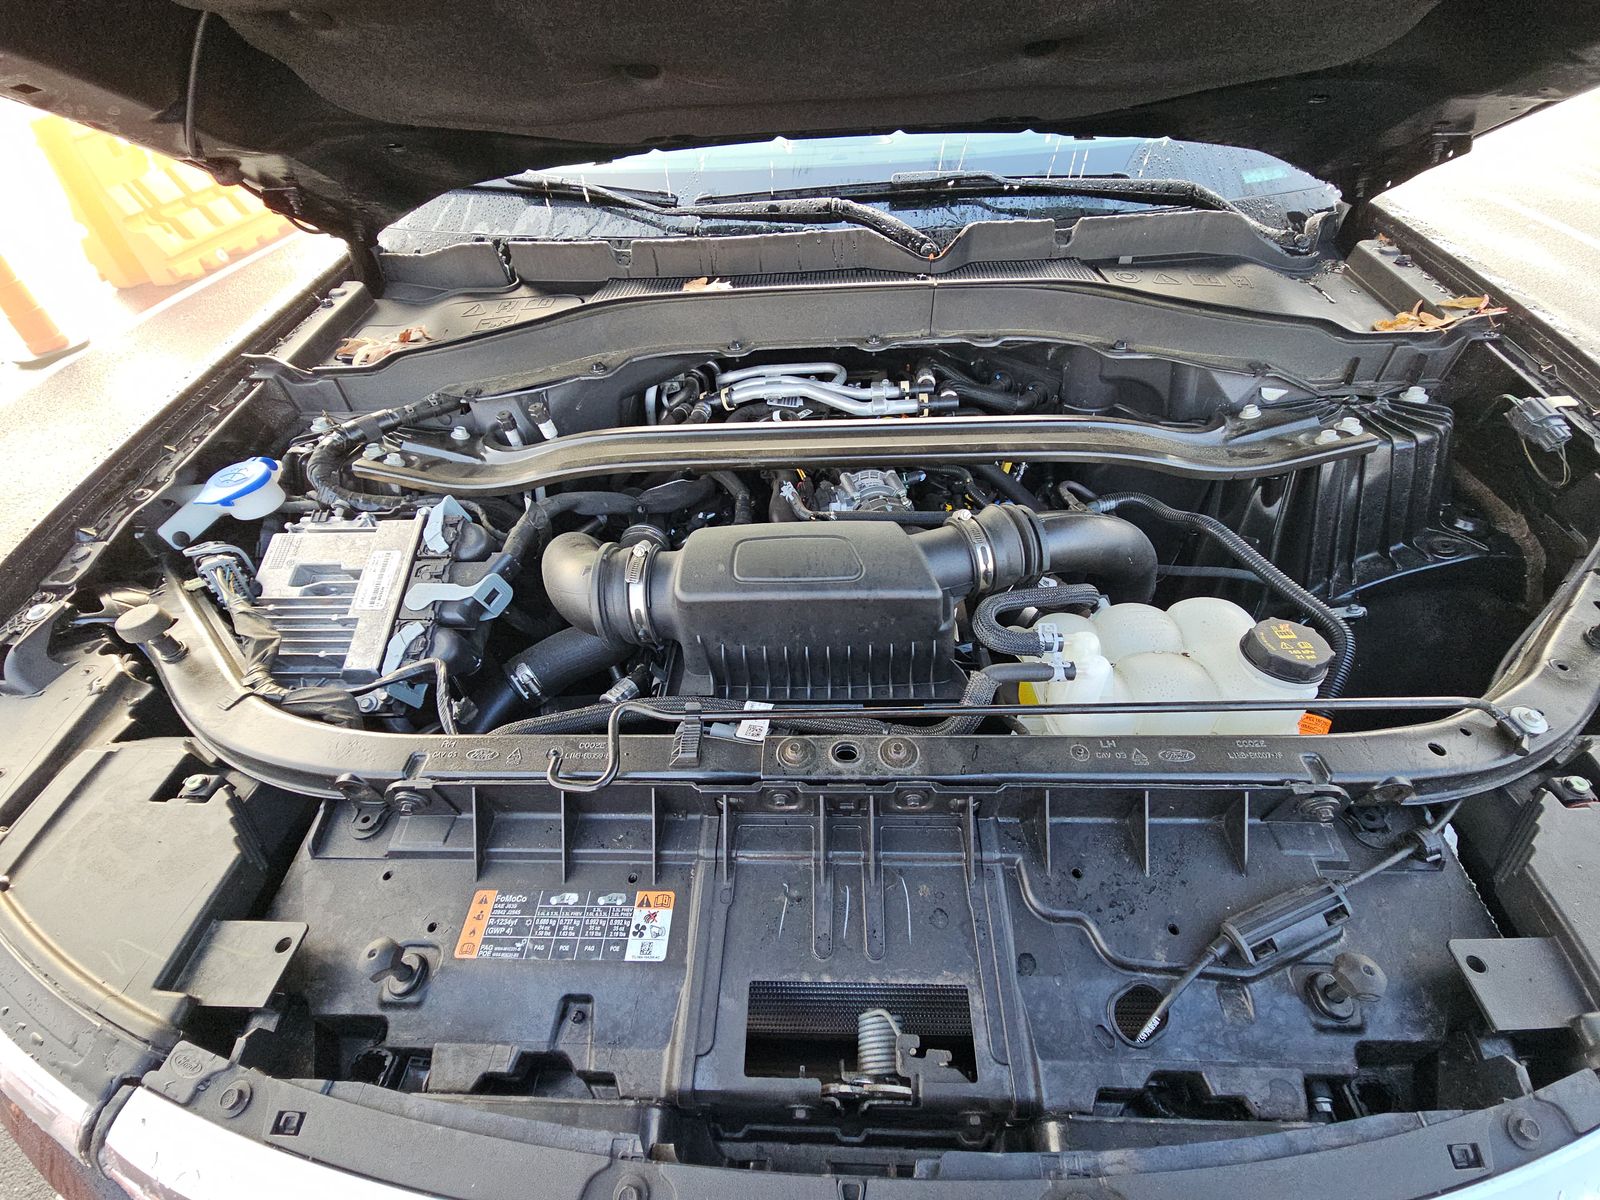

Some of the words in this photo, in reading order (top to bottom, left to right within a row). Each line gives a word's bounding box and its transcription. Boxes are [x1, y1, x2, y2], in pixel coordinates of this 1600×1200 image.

[1100, 740, 1117, 748] LH
[1096, 751, 1111, 759] CAV
[495, 894, 527, 903] FoMoCo
[488, 918, 518, 927] R-1234yf
[573, 919, 580, 927] kg
[599, 919, 606, 927] kg
[623, 919, 631, 927] kg
[486, 927, 505, 936] (GWP
[505, 928, 513, 936] 4)
